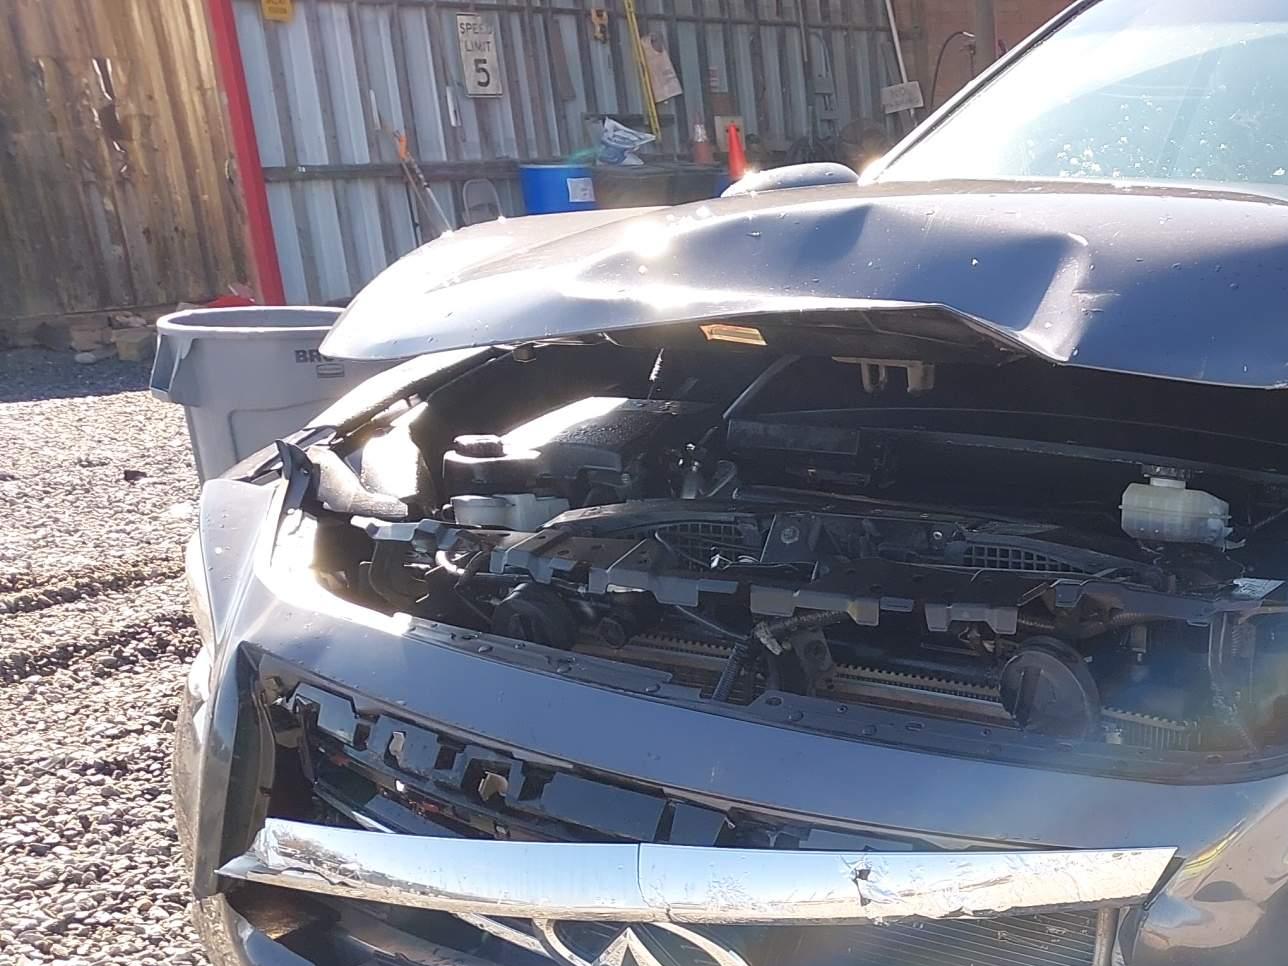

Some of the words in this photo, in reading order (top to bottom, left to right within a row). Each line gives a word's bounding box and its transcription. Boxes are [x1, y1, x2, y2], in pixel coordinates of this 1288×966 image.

[459, 22, 493, 35] SPEED
[464, 40, 491, 52] LIMIT
[474, 58, 490, 87] 5
[294, 349, 335, 363] BR
